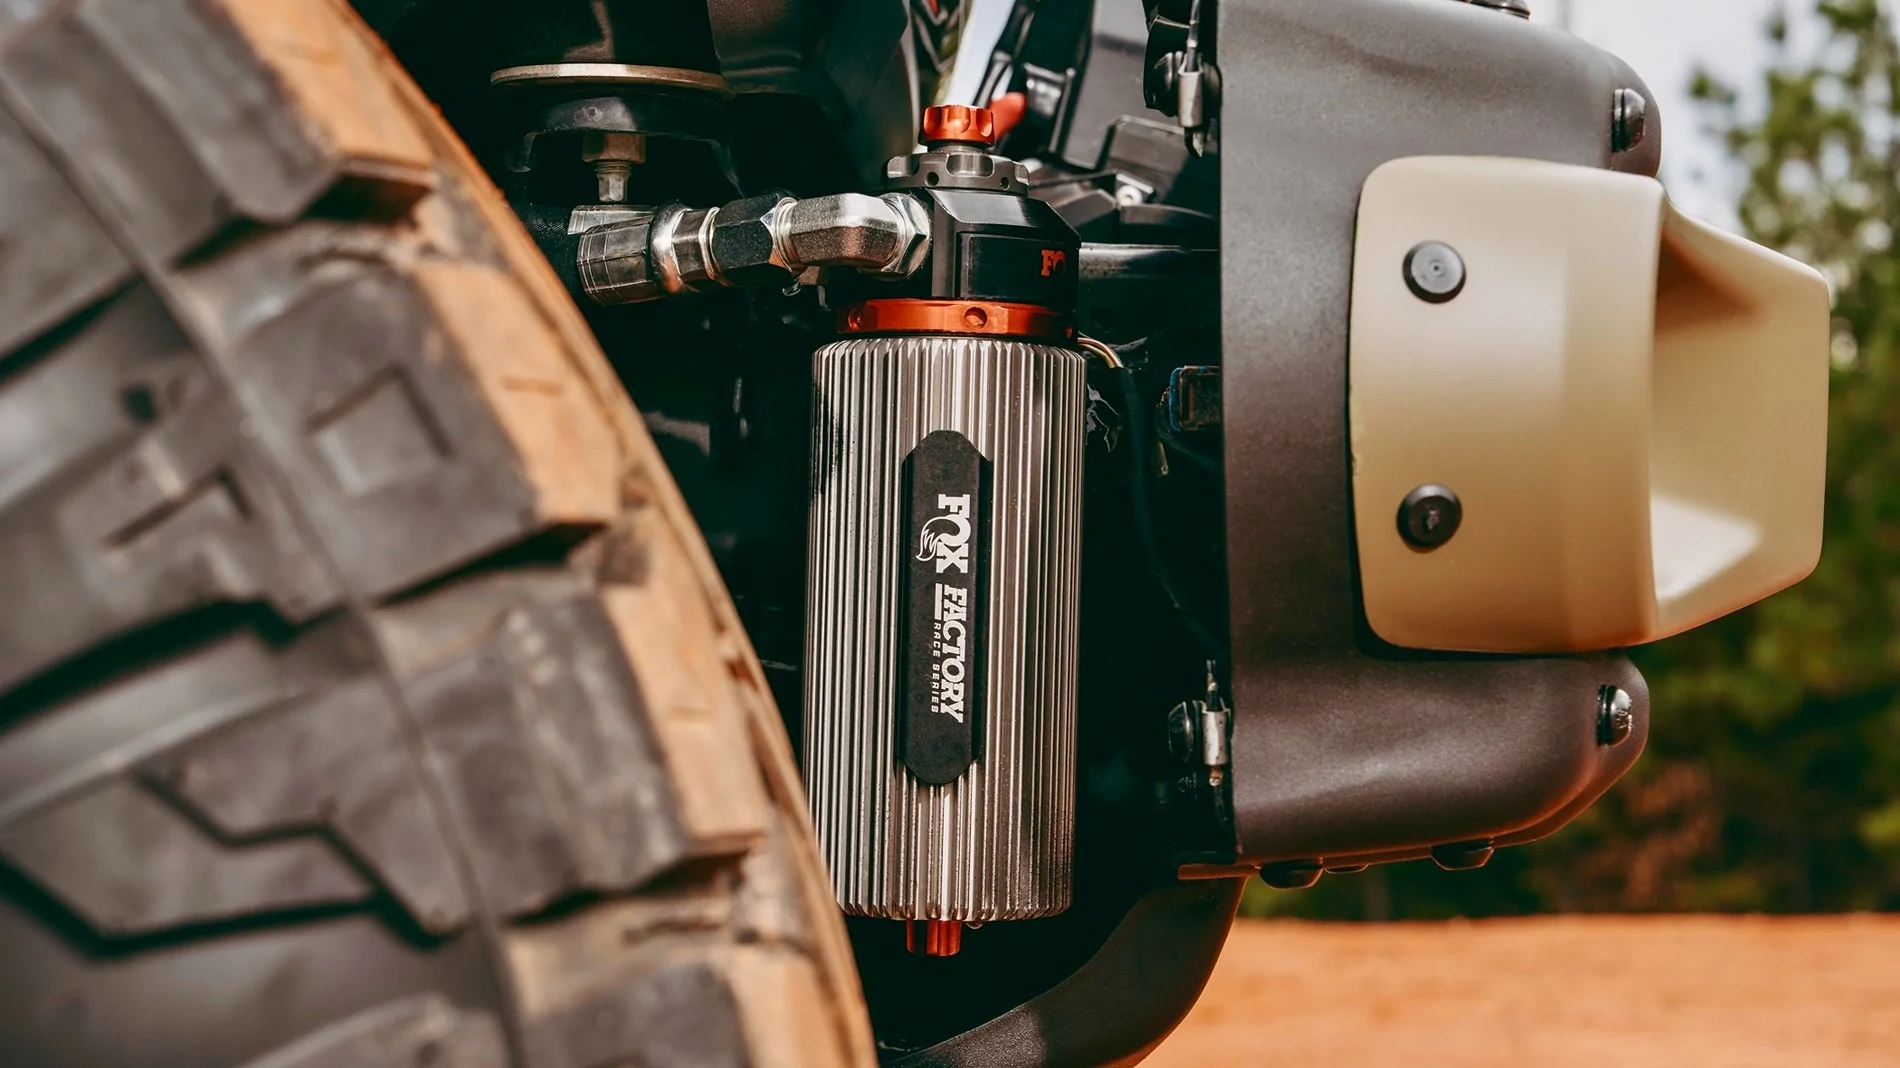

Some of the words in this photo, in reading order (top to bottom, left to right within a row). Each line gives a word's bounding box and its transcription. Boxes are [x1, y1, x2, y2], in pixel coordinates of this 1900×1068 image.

[916, 494, 971, 574] FOX
[933, 622, 942, 657] RACE
[941, 584, 968, 724] FACTORY
[931, 663, 940, 713] SERIES
